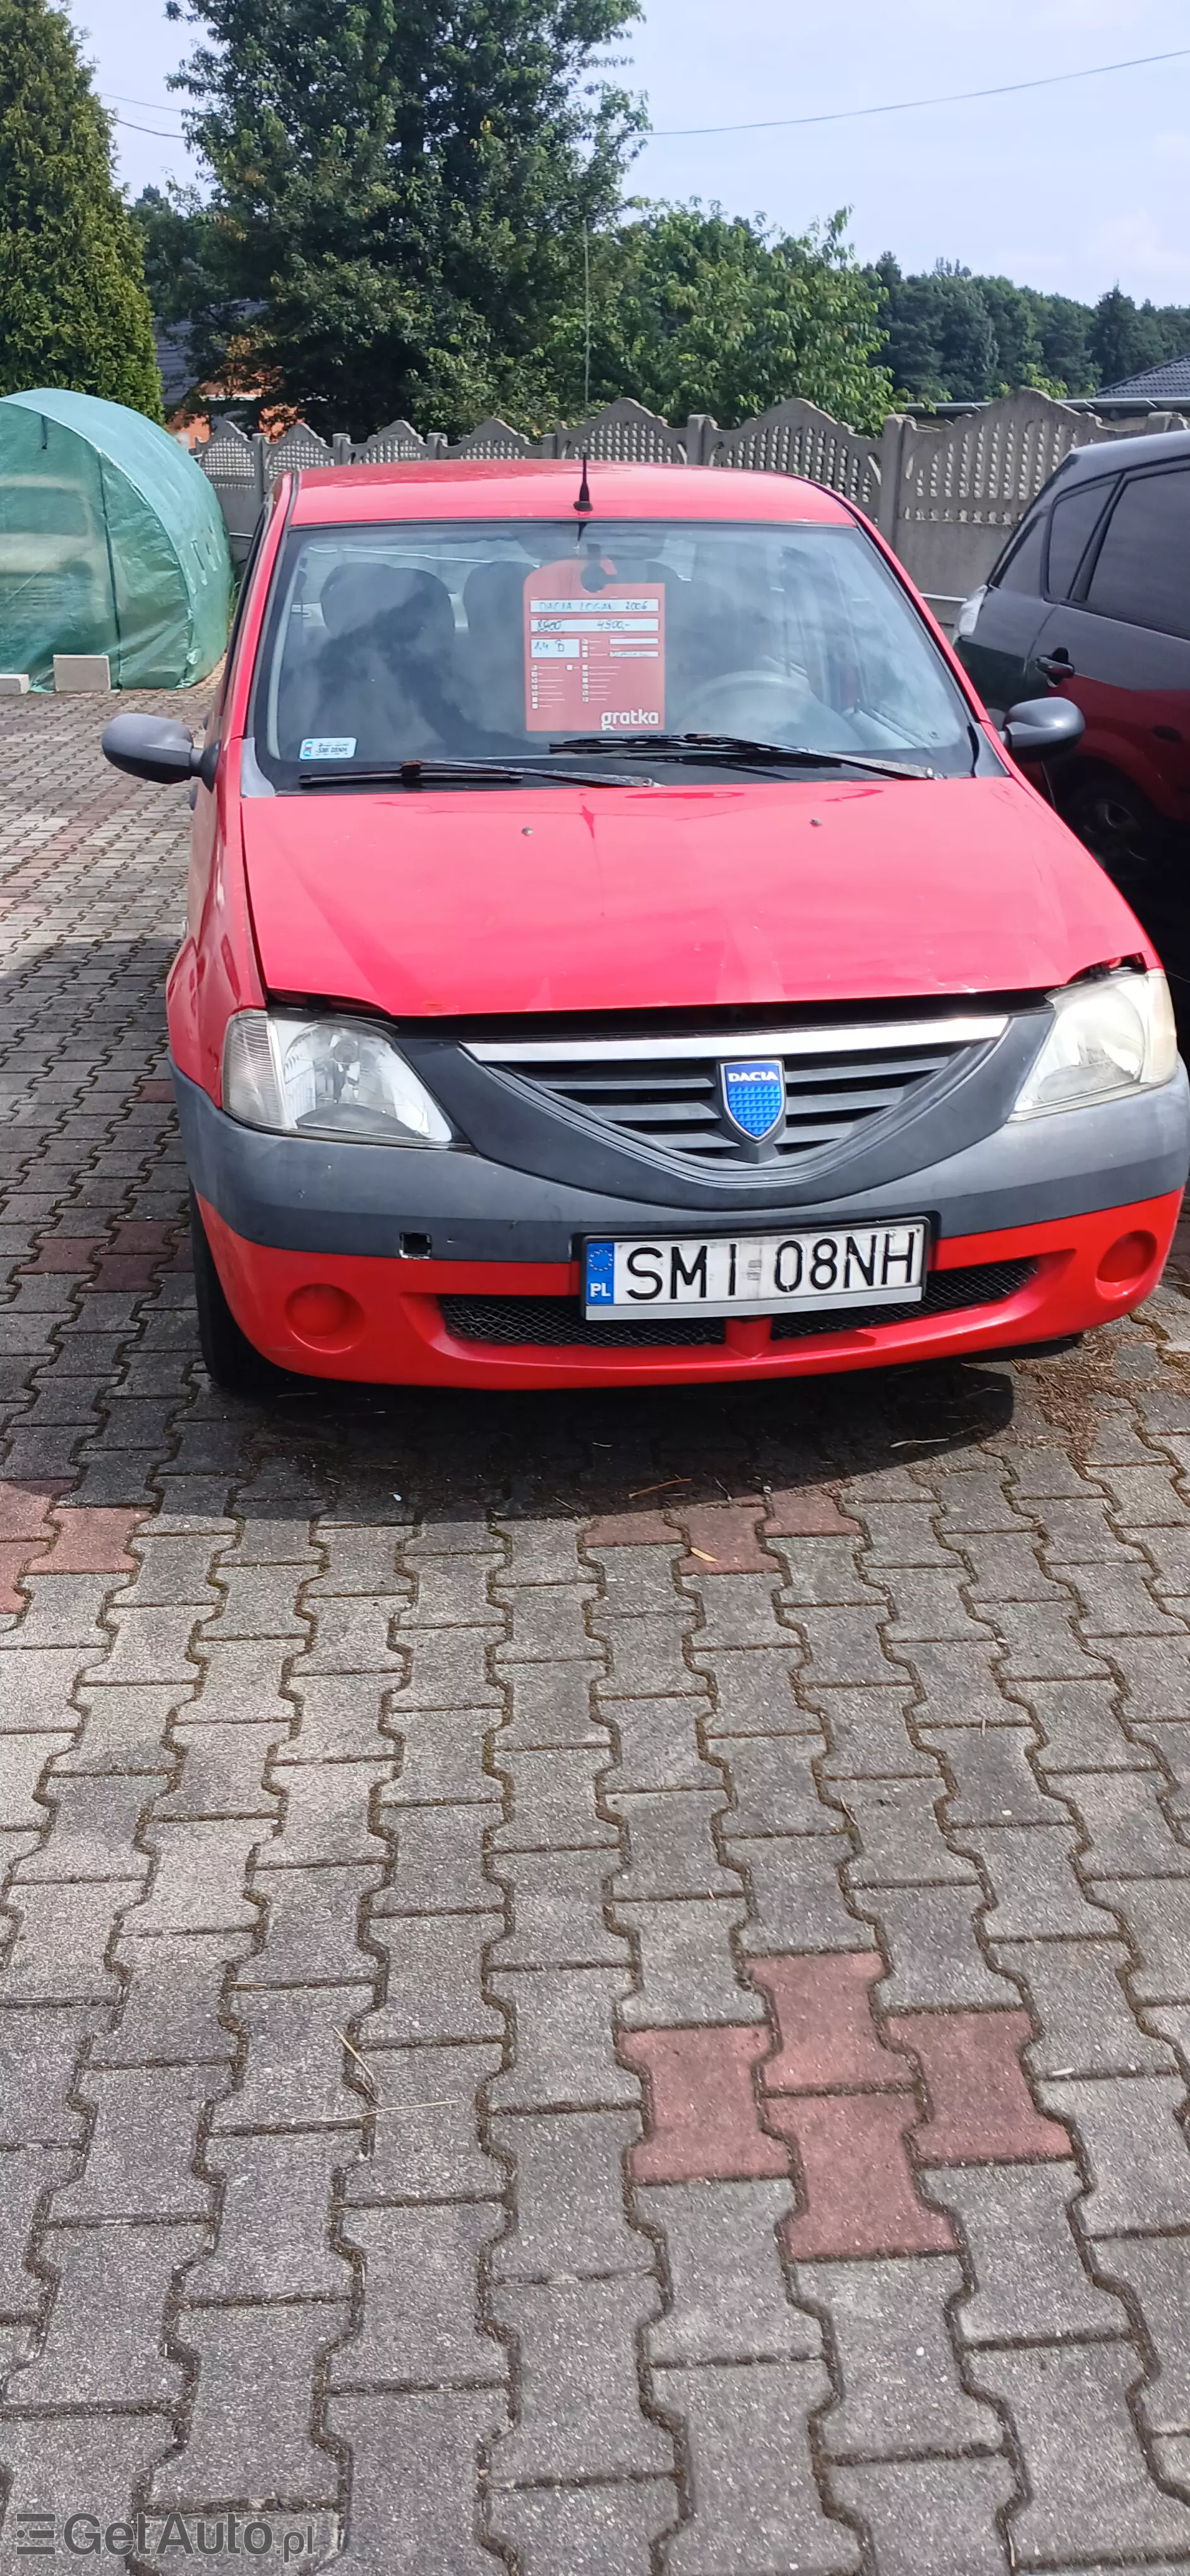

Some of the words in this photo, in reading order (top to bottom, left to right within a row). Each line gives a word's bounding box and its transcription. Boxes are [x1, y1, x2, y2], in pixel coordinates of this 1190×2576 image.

[539, 601, 572, 611] DACIA
[625, 600, 648, 610] 2006
[601, 708, 659, 730] gratka
[727, 1071, 779, 1082] DACIA
[626, 1243, 738, 1300] SMI
[774, 1231, 916, 1292] 08NH
[590, 1282, 611, 1297] PL
